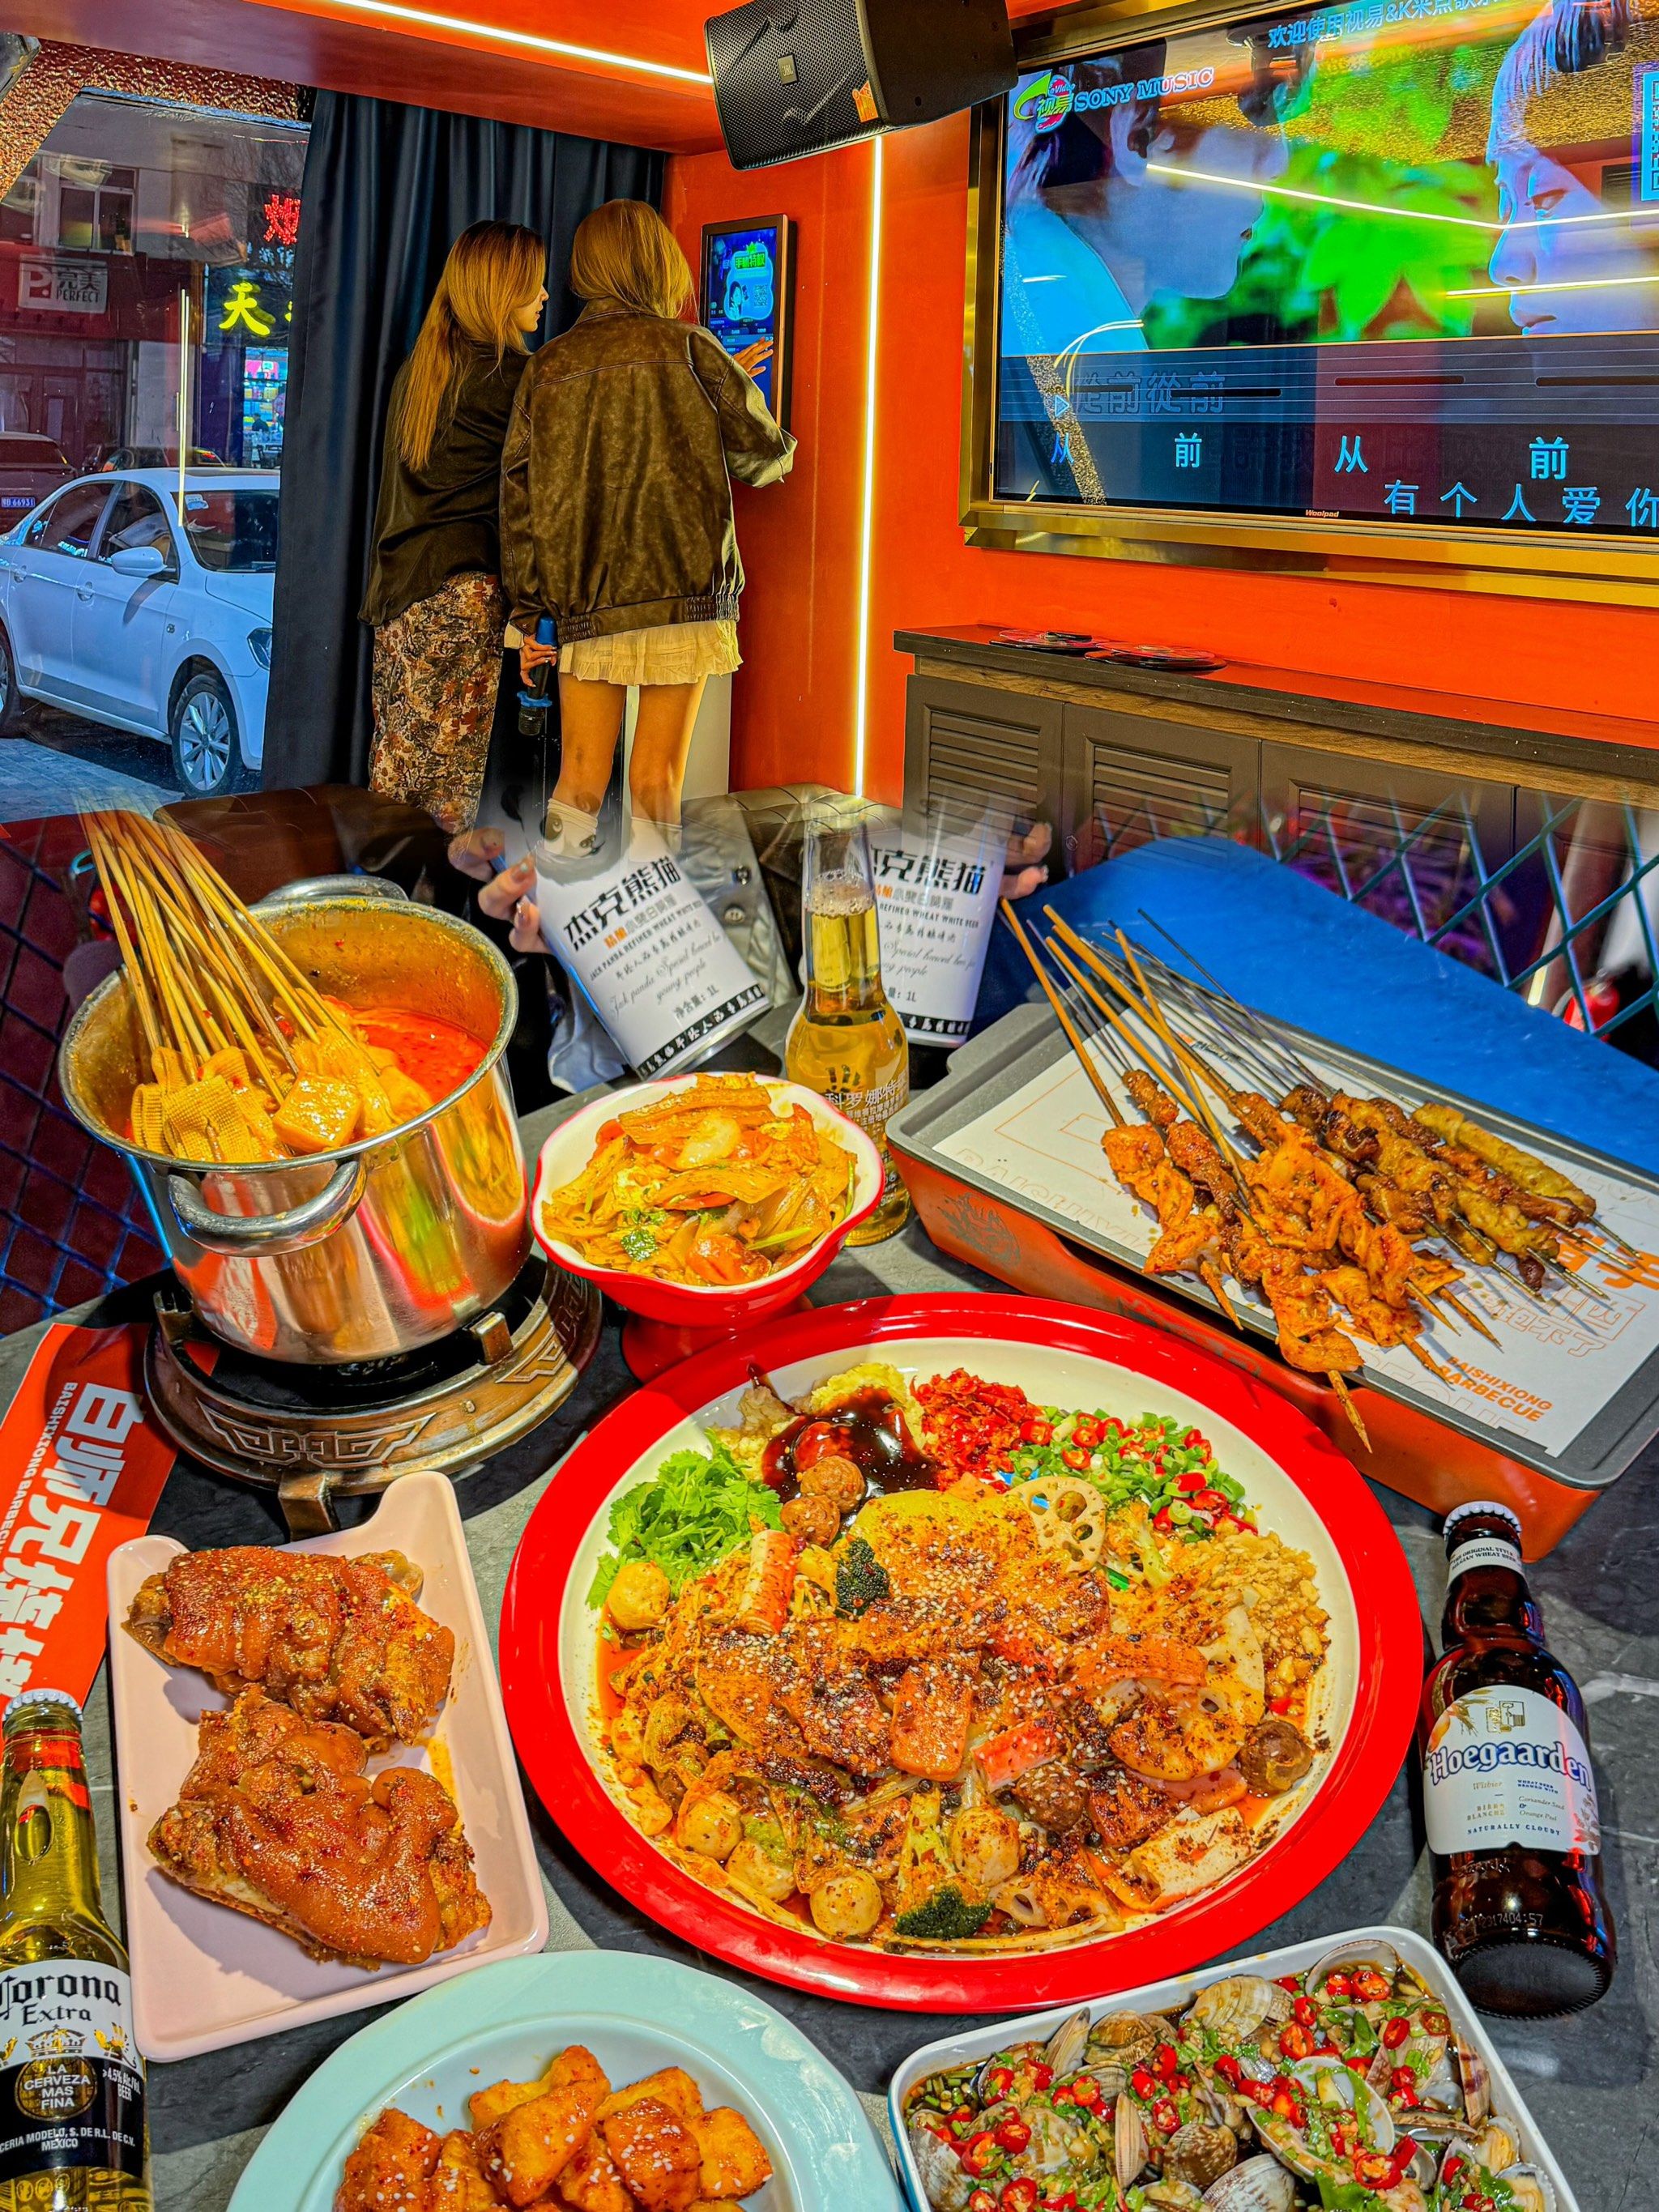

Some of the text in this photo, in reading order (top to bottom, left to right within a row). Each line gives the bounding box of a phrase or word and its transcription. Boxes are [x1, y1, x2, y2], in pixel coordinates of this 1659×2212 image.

[1268, 0, 1498, 48] 欢迎使用视易&K米点
[1074, 67, 1216, 112] SONY MUSIC
[56, 289, 99, 303] PERFECT
[218, 283, 292, 336] 天
[564, 855, 682, 953] 杰克熊猫
[879, 902, 910, 915] REFINED
[912, 909, 939, 921] WHEAT
[941, 915, 963, 927] WHITE
[590, 966, 603, 981] JACK
[602, 949, 624, 970] PANDA
[623, 929, 653, 953] REFINED
[652, 913, 676, 932] WHEAT
[1447, 1357, 1553, 1410] BAISHIXIONG
[23, 1381, 79, 1479] BAISHIXIONG
[1462, 1546, 1495, 1558] ORIGINAL
[1429, 1741, 1592, 1792] Hoegaarden
[1467, 1823, 1561, 1835] NATURALLY CLOUDY
[22, 2002, 92, 2027] Extra
[47, 2064, 67, 2075] LA
[23, 2074, 91, 2091] CERVEZA
[42, 2086, 75, 2099] MAS
[117, 2083, 133, 2102] BEER
[41, 2097, 75, 2110] FINA
[69, 2126, 79, 2137] S.
[80, 2126, 93, 2137] DE
[94, 2128, 111, 2140] R.L.
[112, 2131, 125, 2143] DE
